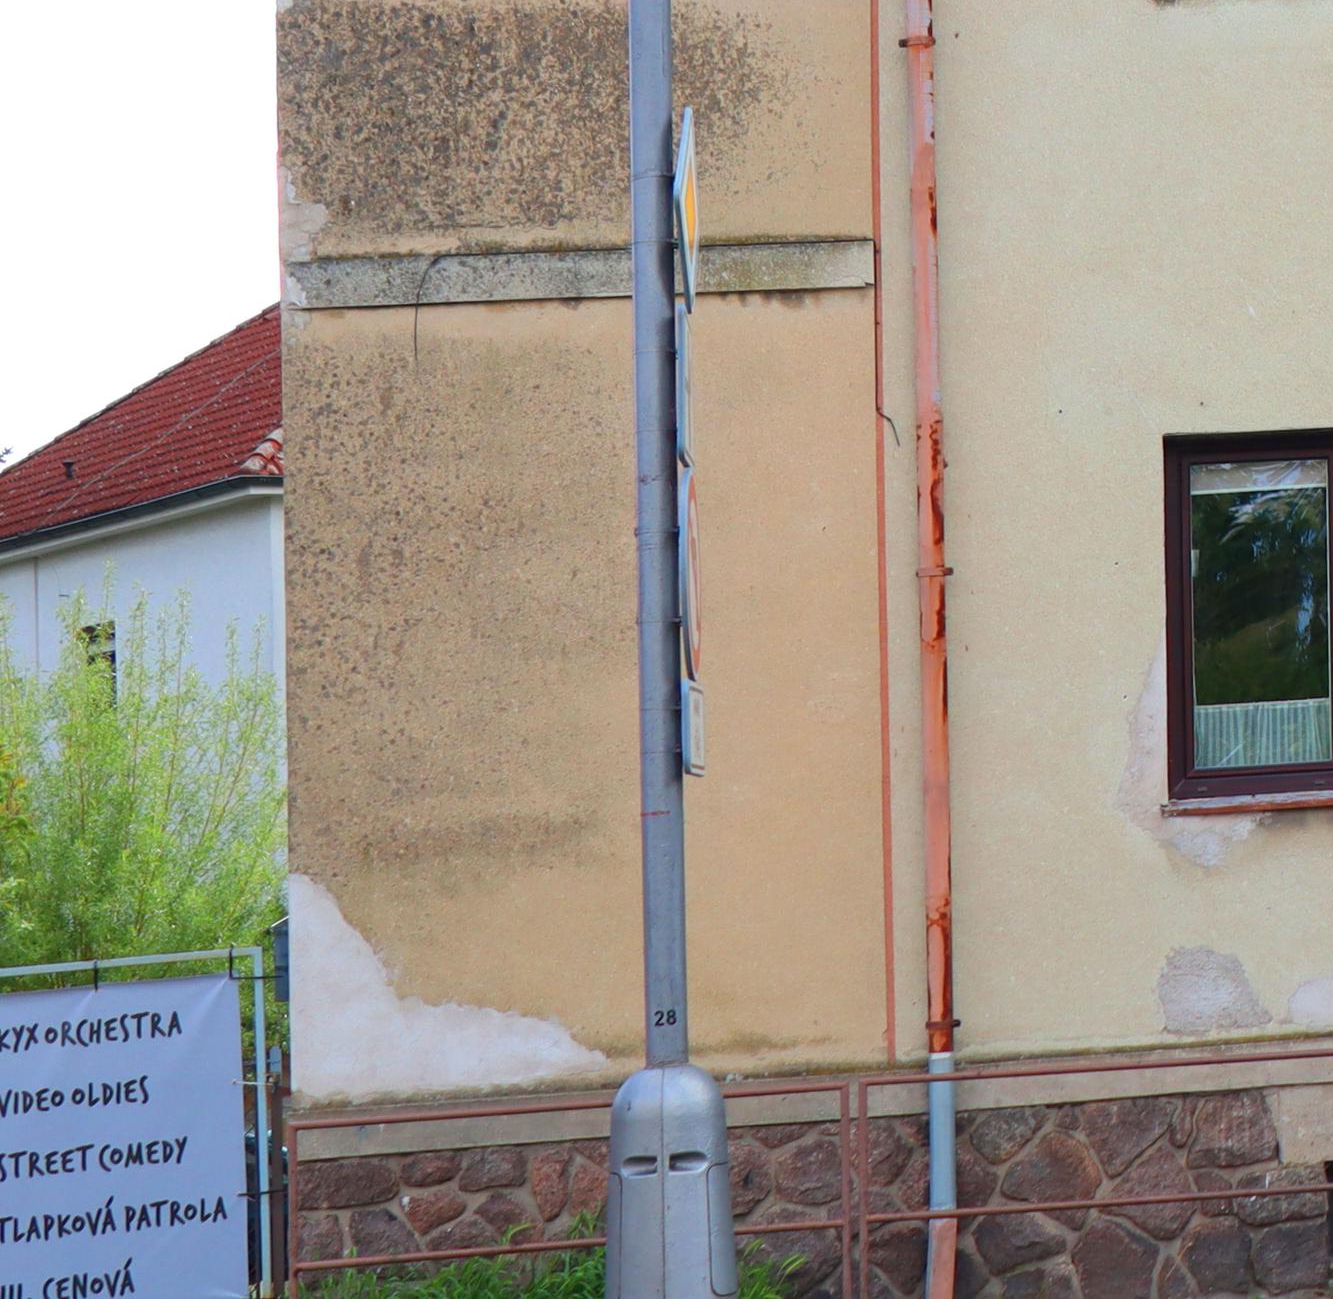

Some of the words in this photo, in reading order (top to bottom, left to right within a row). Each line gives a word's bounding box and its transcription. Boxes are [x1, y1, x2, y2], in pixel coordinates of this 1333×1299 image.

[45, 1011, 182, 1047] ORCHESTRA
[654, 1009, 677, 1027] 28
[0, 1088, 63, 1118] VIDEO
[71, 1075, 150, 1107] OLDIES
[100, 1136, 188, 1172] COMEDY
[0, 1195, 117, 1243] TLAPKOVÁ
[124, 1195, 228, 1234] PATROLA
[43, 1257, 136, 1299] CENOVÁ
